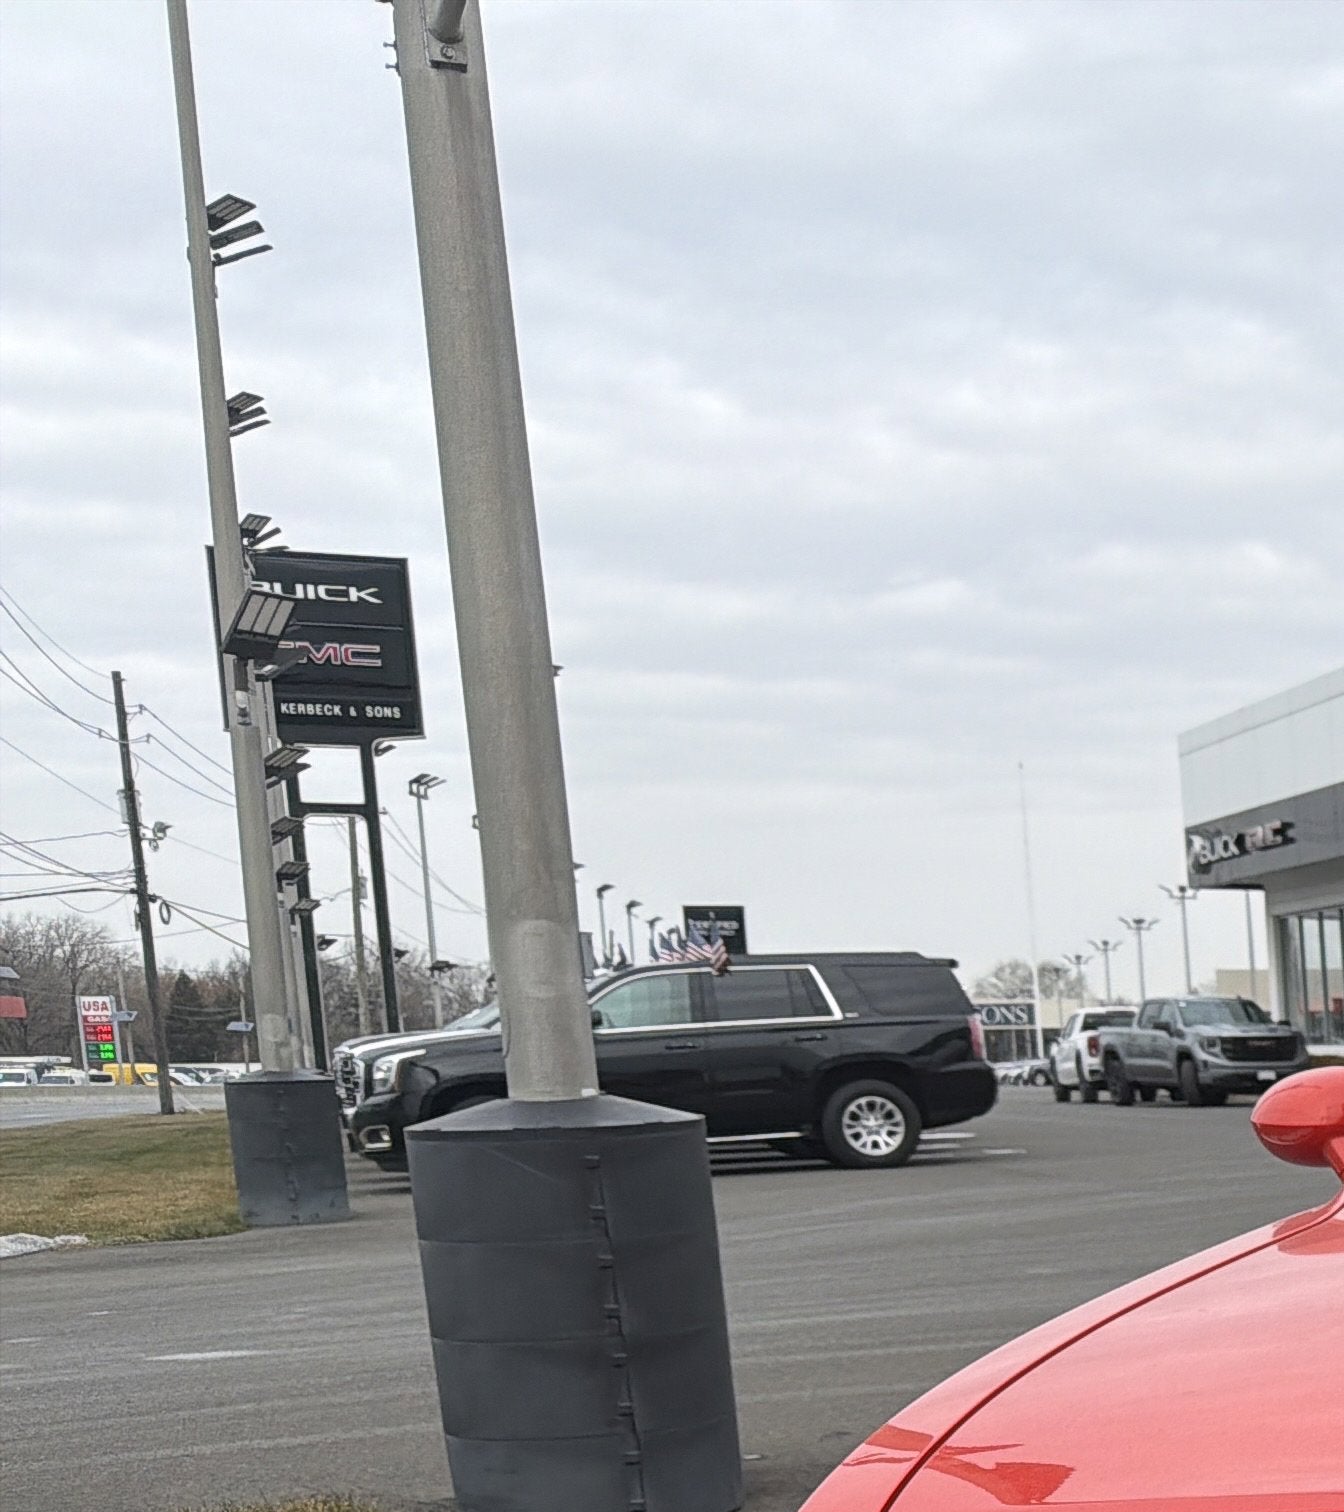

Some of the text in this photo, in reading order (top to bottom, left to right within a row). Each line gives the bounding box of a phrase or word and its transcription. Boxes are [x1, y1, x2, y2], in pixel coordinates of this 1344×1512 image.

[277, 640, 382, 667] MC
[280, 702, 342, 717] KERBECK
[365, 704, 401, 719] SONS
[82, 1001, 109, 1012] USA
